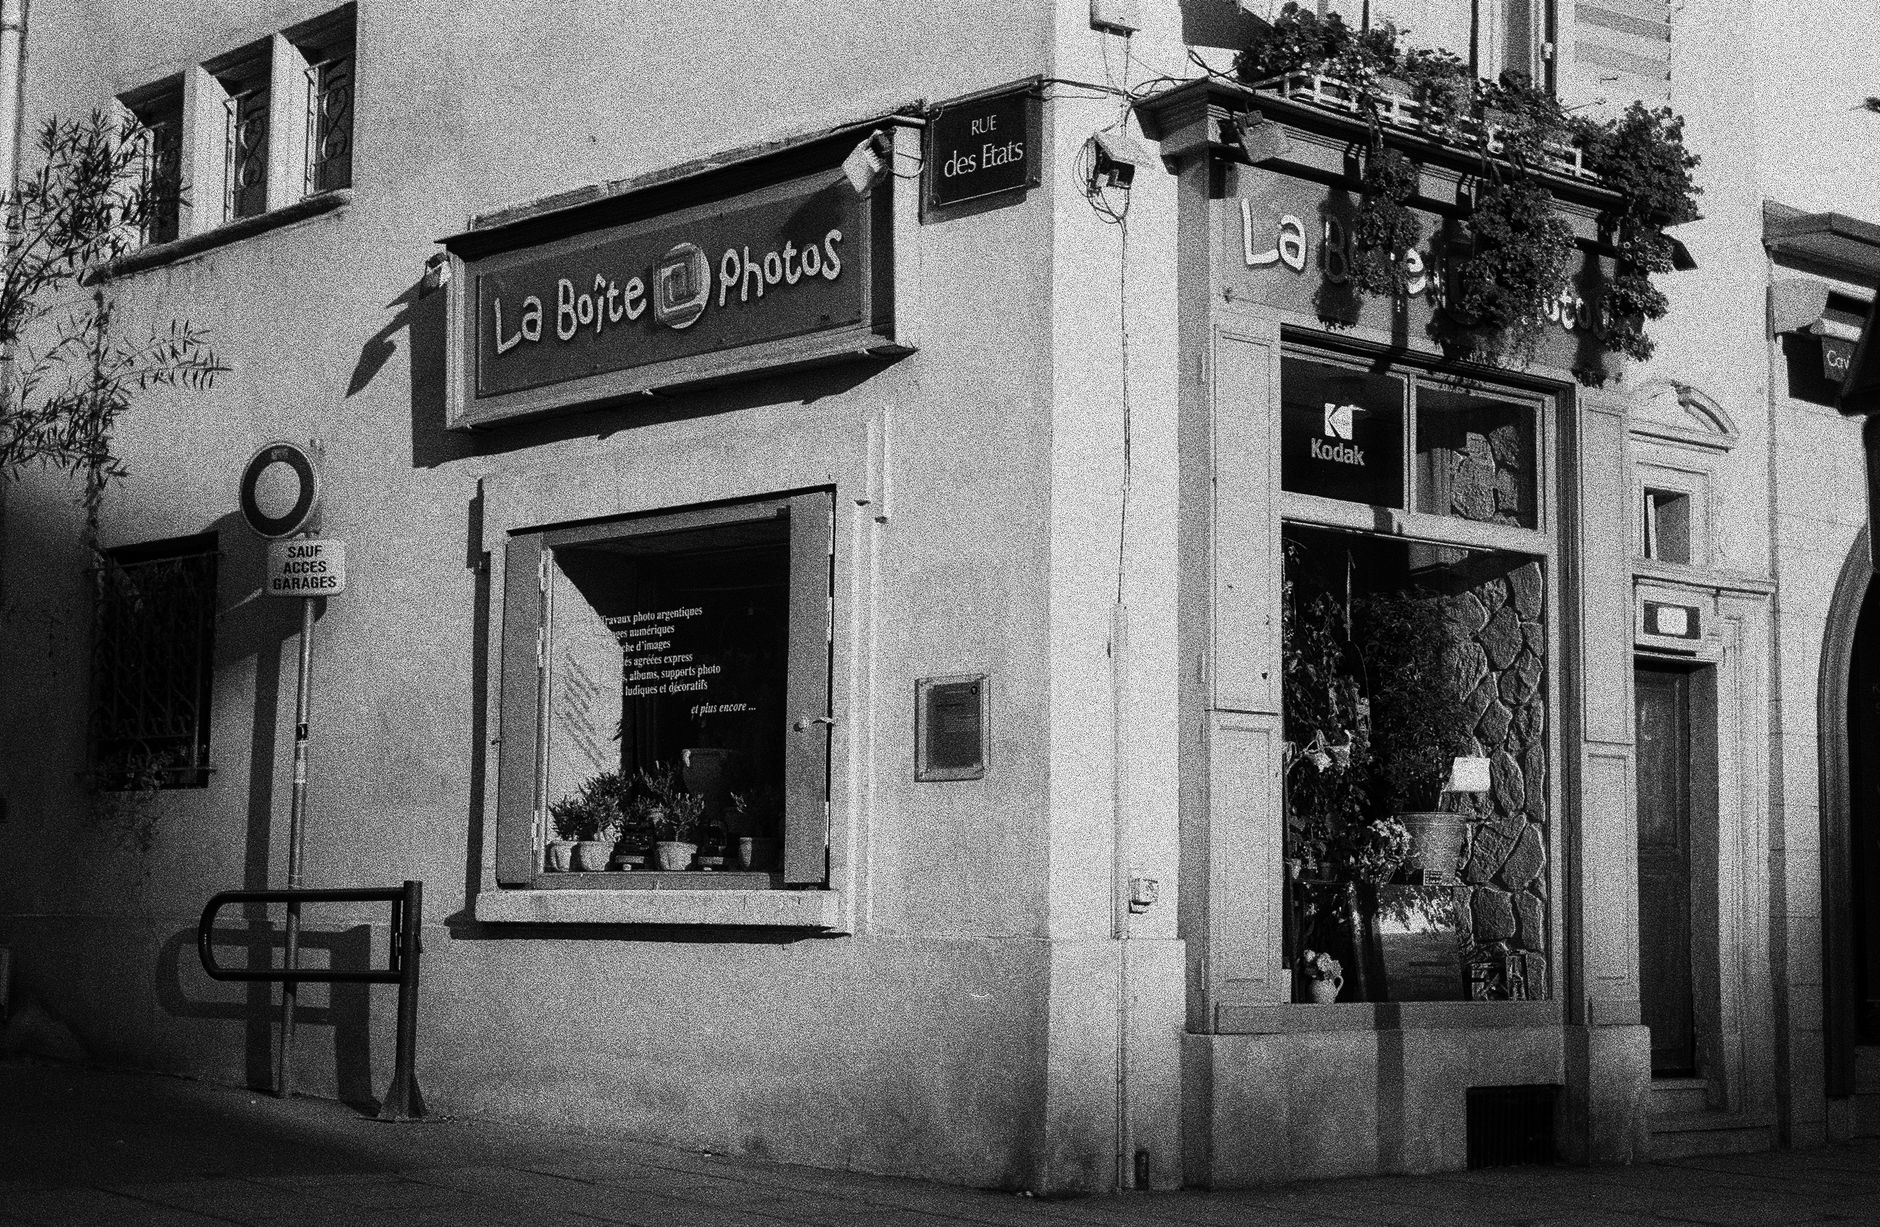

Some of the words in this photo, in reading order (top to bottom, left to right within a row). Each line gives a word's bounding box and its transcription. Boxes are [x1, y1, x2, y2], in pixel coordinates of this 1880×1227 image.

[971, 114, 997, 136] RUE
[944, 150, 977, 178] des
[982, 141, 1024, 169] Etats
[1241, 198, 1307, 272] La
[494, 295, 543, 354] La
[1311, 437, 1366, 467] Kodak
[287, 545, 323, 559] SAUF
[283, 561, 327, 575] ACCES
[273, 576, 337, 590] GARAGES
[633, 611, 655, 625] photo
[656, 606, 702, 621] argentiques
[629, 624, 675, 637] numériques
[663, 653, 693, 666] express
[661, 666, 696, 680] supports
[697, 664, 721, 678] photo
[625, 685, 658, 698] ludiques
[659, 683, 667, 694] et
[668, 679, 708, 694] décoratifs
[691, 704, 699, 714] et
[699, 702, 718, 717] plus
[719, 702, 747, 713] encore
